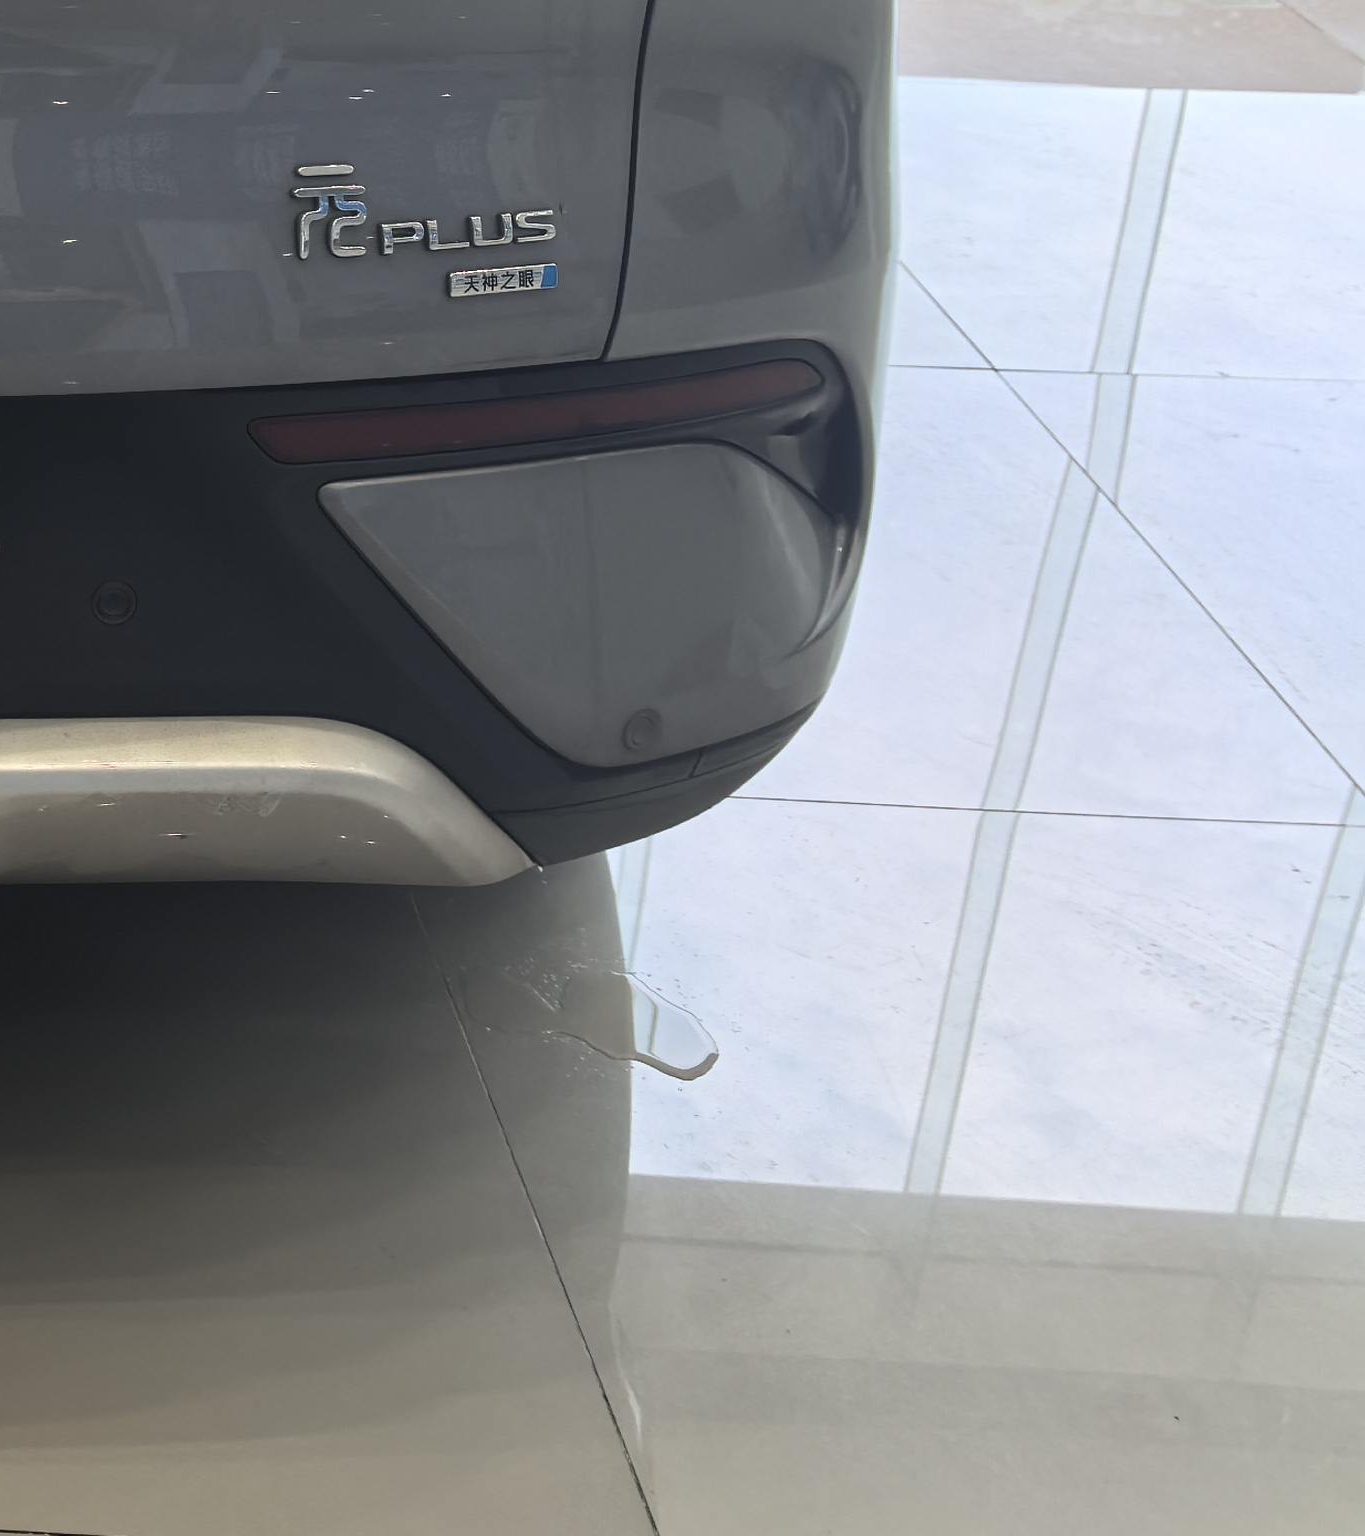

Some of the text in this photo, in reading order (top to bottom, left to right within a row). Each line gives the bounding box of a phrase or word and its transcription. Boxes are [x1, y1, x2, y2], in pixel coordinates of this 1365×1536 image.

[380, 208, 557, 255] PLUS
[463, 268, 536, 294] 天神之眼
